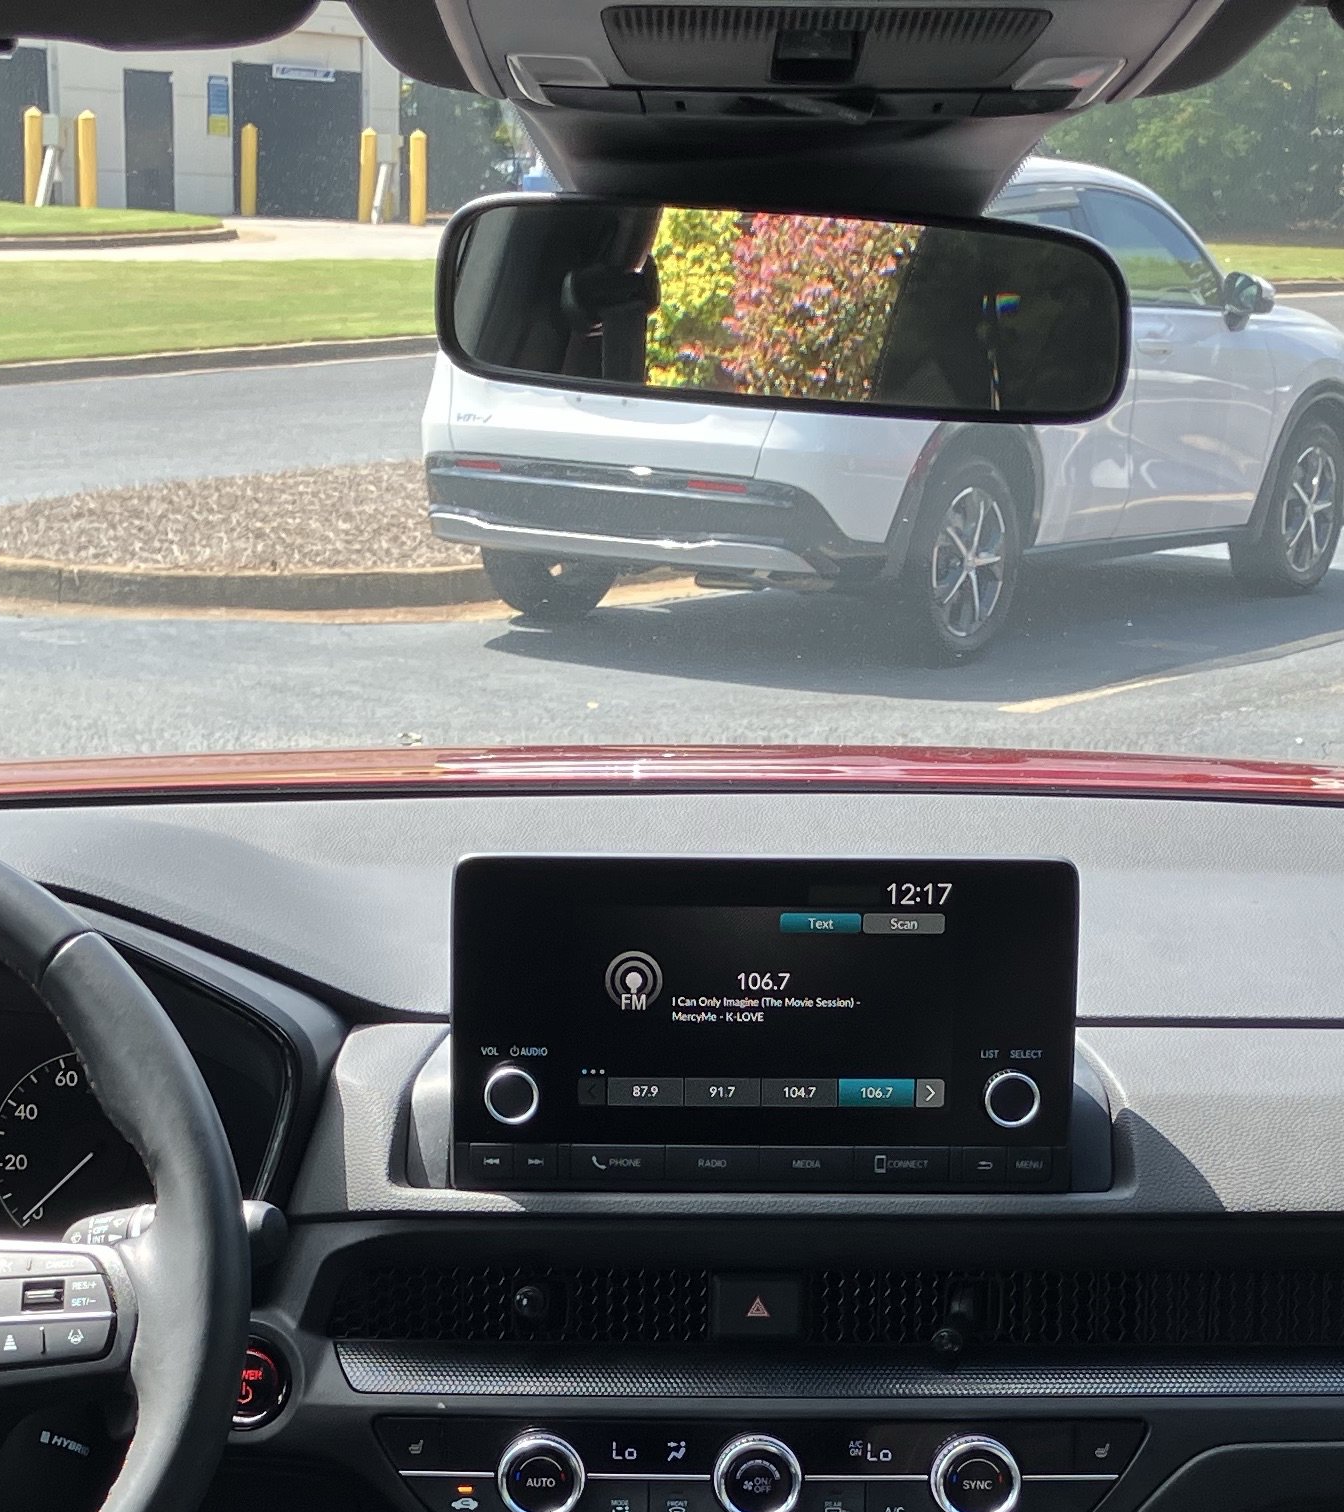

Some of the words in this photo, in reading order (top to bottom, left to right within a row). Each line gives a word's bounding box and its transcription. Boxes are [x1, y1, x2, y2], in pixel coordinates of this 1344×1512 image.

[886, 883, 953, 906] 12:17
[808, 917, 834, 930] Text
[891, 918, 919, 930] Scan
[737, 972, 791, 991] 106.7
[620, 994, 647, 1011] FM
[671, 997, 675, 1007] I
[678, 997, 696, 1007] Can
[698, 997, 721, 1008] Only
[724, 997, 759, 1008] Imagine
[761, 997, 782, 1008] (The
[785, 997, 814, 1008] Movie
[816, 997, 854, 1008] Session)
[672, 1012, 716, 1024] MercyMe
[725, 1012, 765, 1022] K-LOVE
[481, 1046, 499, 1056] VOL
[521, 1046, 548, 1057] AUDIO
[980, 1049, 999, 1059] LIST
[1009, 1049, 1043, 1059] SELECT
[54, 1070, 78, 1087] 60
[632, 1086, 659, 1098] 87.9
[709, 1086, 736, 1098] 91.7
[783, 1087, 817, 1098] 104.7
[860, 1087, 894, 1099] 106.7
[14, 1104, 38, 1120] 40
[5, 1154, 28, 1170] 20
[609, 1158, 641, 1168] PHONE
[698, 1158, 727, 1168] RADIO
[792, 1160, 821, 1169] MEDIA
[887, 1159, 929, 1169] CONNECT
[1016, 1160, 1044, 1169] MENU
[92, 1235, 105, 1244] INT
[241, 1369, 263, 1381] WER
[612, 1441, 637, 1460] Lo
[848, 1441, 864, 1449] A/C
[850, 1449, 863, 1457] ON
[867, 1442, 892, 1461] Lo
[526, 1477, 556, 1488] AUTO
[962, 1480, 993, 1490] SYNC
[754, 1486, 772, 1494] OFF
